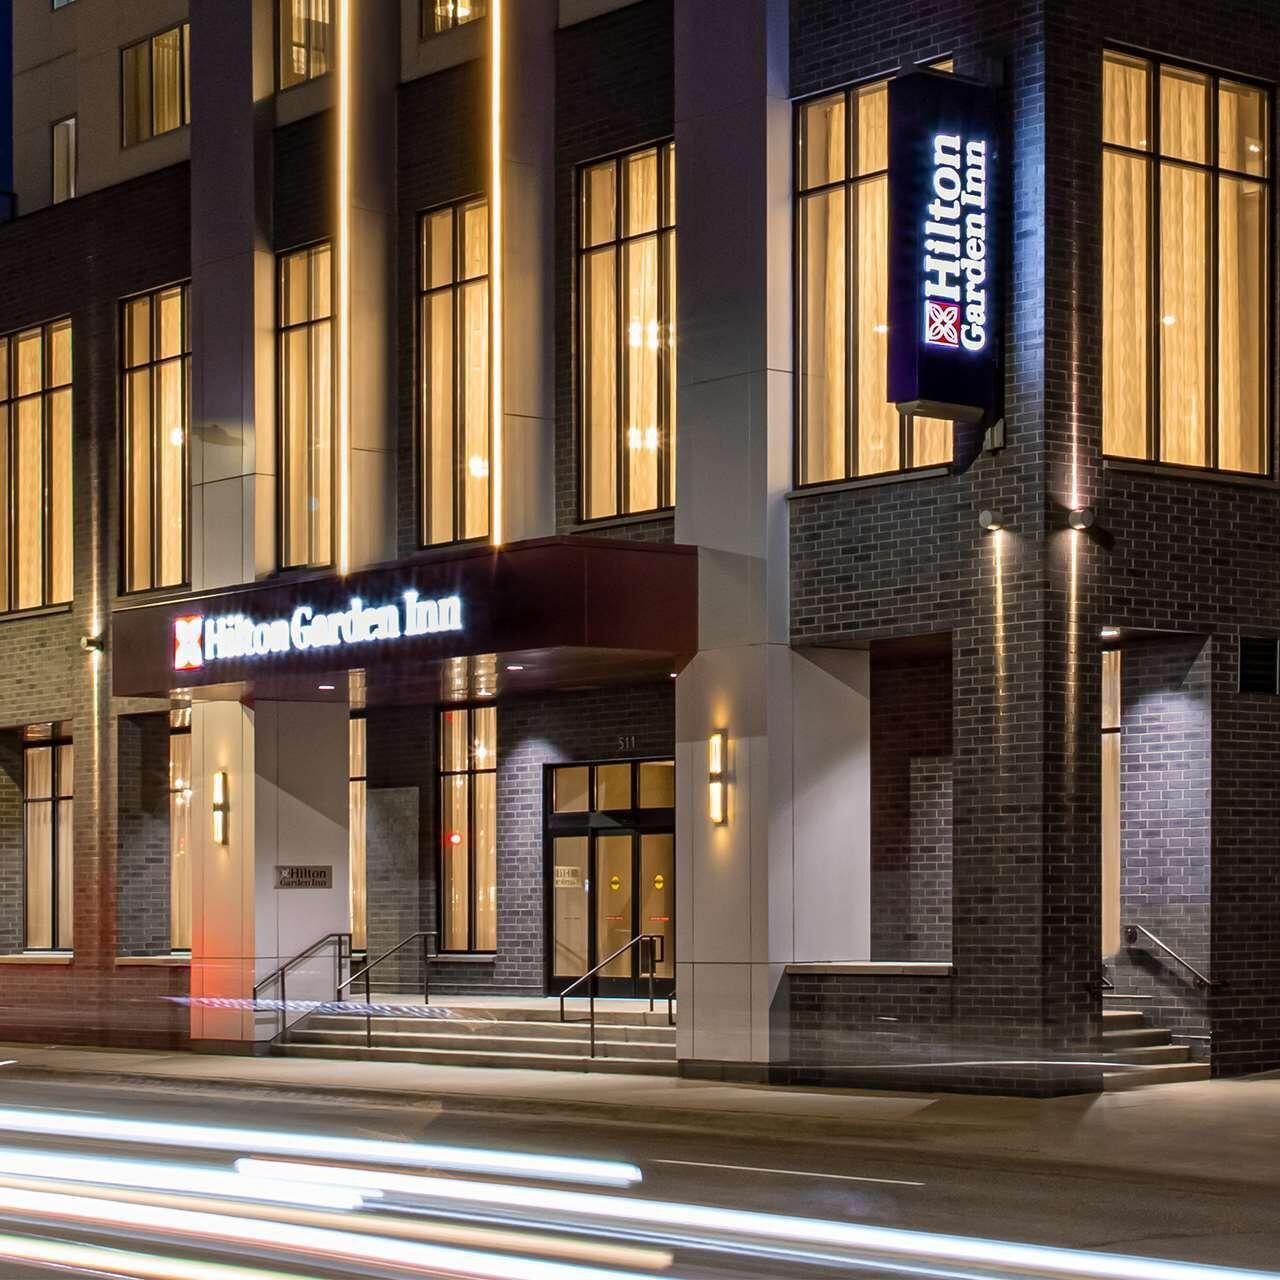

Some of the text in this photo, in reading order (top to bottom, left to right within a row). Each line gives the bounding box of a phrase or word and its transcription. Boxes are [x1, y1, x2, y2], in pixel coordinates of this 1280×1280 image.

[925, 133, 961, 301] Hilton
[960, 140, 987, 352] Garden Inn
[204, 590, 463, 660] Hilton Garden Inn
[618, 735, 635, 750] 511
[290, 868, 327, 879] Hilton
